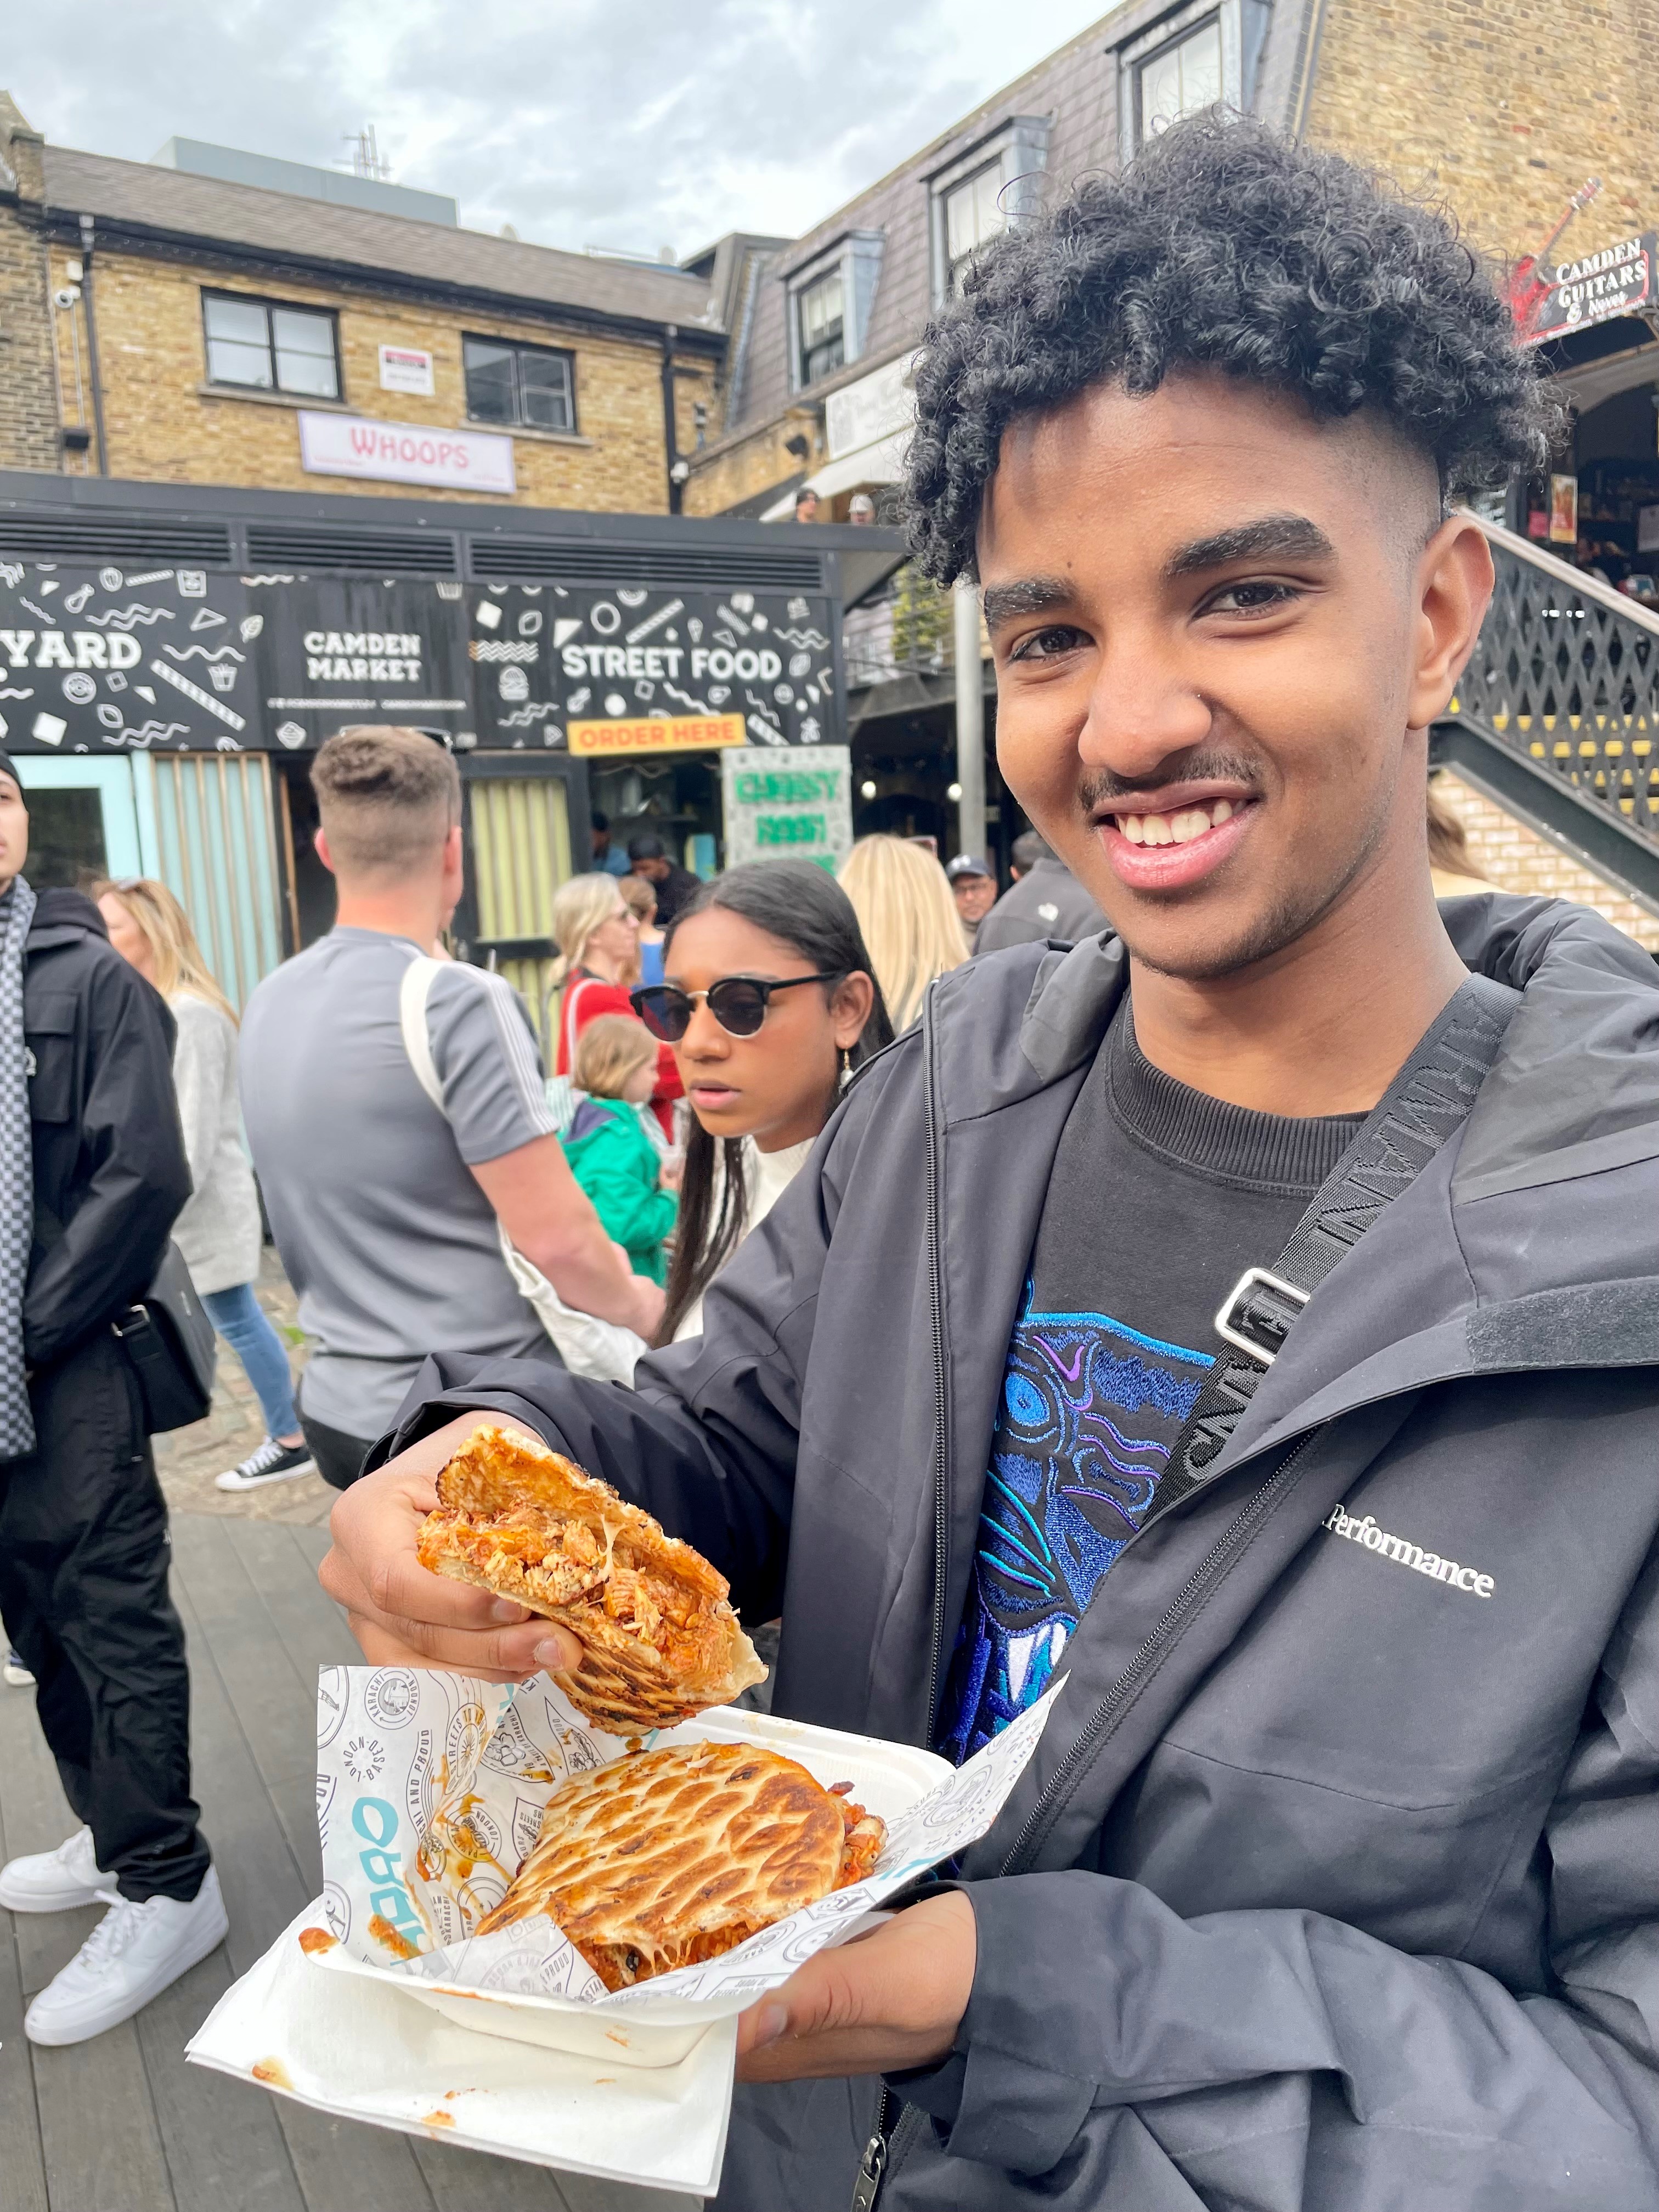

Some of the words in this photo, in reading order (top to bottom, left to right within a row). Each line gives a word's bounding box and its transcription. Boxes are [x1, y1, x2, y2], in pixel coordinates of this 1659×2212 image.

[1556, 238, 1641, 285] CAMDEN
[1558, 259, 1646, 308] GUITARS
[1566, 302, 1583, 324] &
[350, 427, 470, 469] WHOOPS
[0, 630, 142, 669] YARD
[303, 631, 421, 656] CAMDEN
[307, 657, 422, 681] MARKET
[562, 644, 685, 679] STREET
[691, 648, 782, 680] FOOD
[579, 726, 665, 749] ORDER
[673, 721, 735, 742] HERE
[1322, 1503, 1495, 1598] Performance
[368, 1674, 385, 1718] KARACHI
[407, 1679, 417, 1716] LONDON
[414, 1729, 430, 1773] PROUD
[410, 1779, 420, 1804] AND
[476, 1810, 499, 1841] LONDON
[544, 1952, 569, 1981] PROUD
